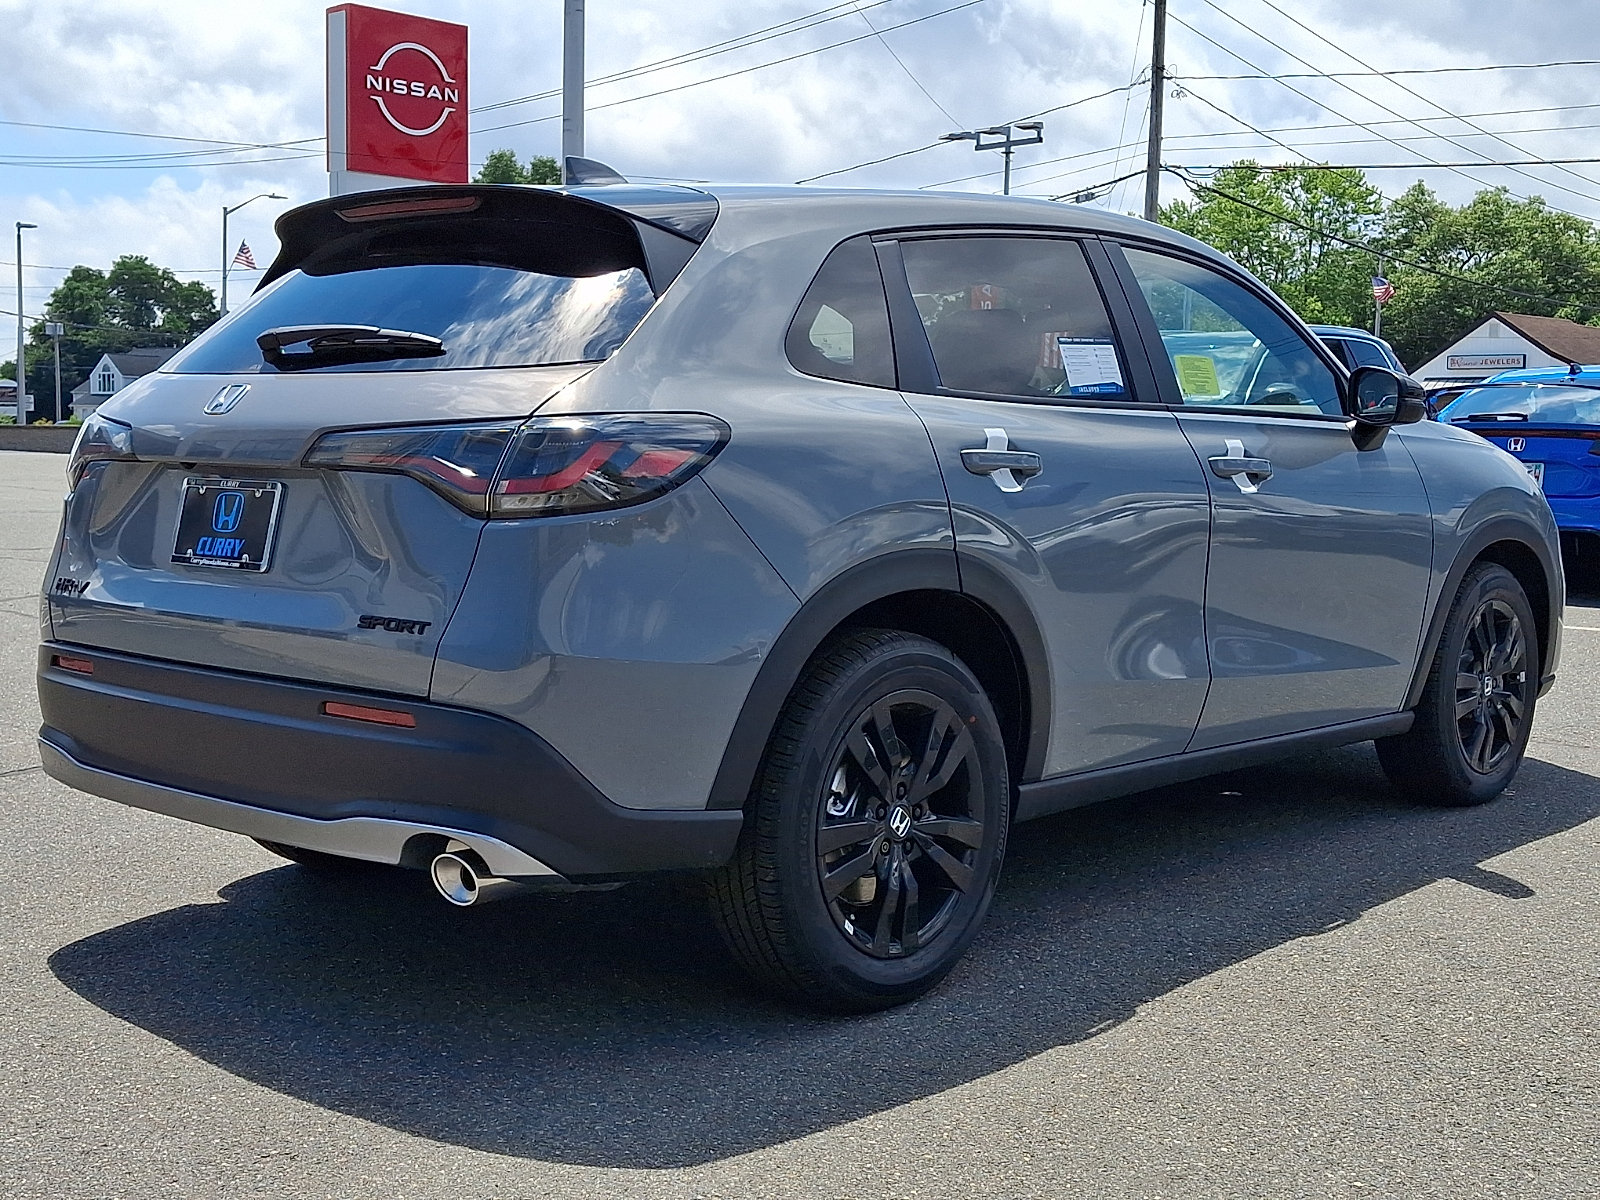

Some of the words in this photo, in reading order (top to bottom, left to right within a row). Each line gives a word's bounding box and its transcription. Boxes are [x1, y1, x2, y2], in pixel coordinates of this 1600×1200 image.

[366, 74, 459, 103] NISSAN
[220, 480, 241, 488] CURRY
[196, 536, 245, 558] CURRY
[357, 614, 432, 636] SPORT
